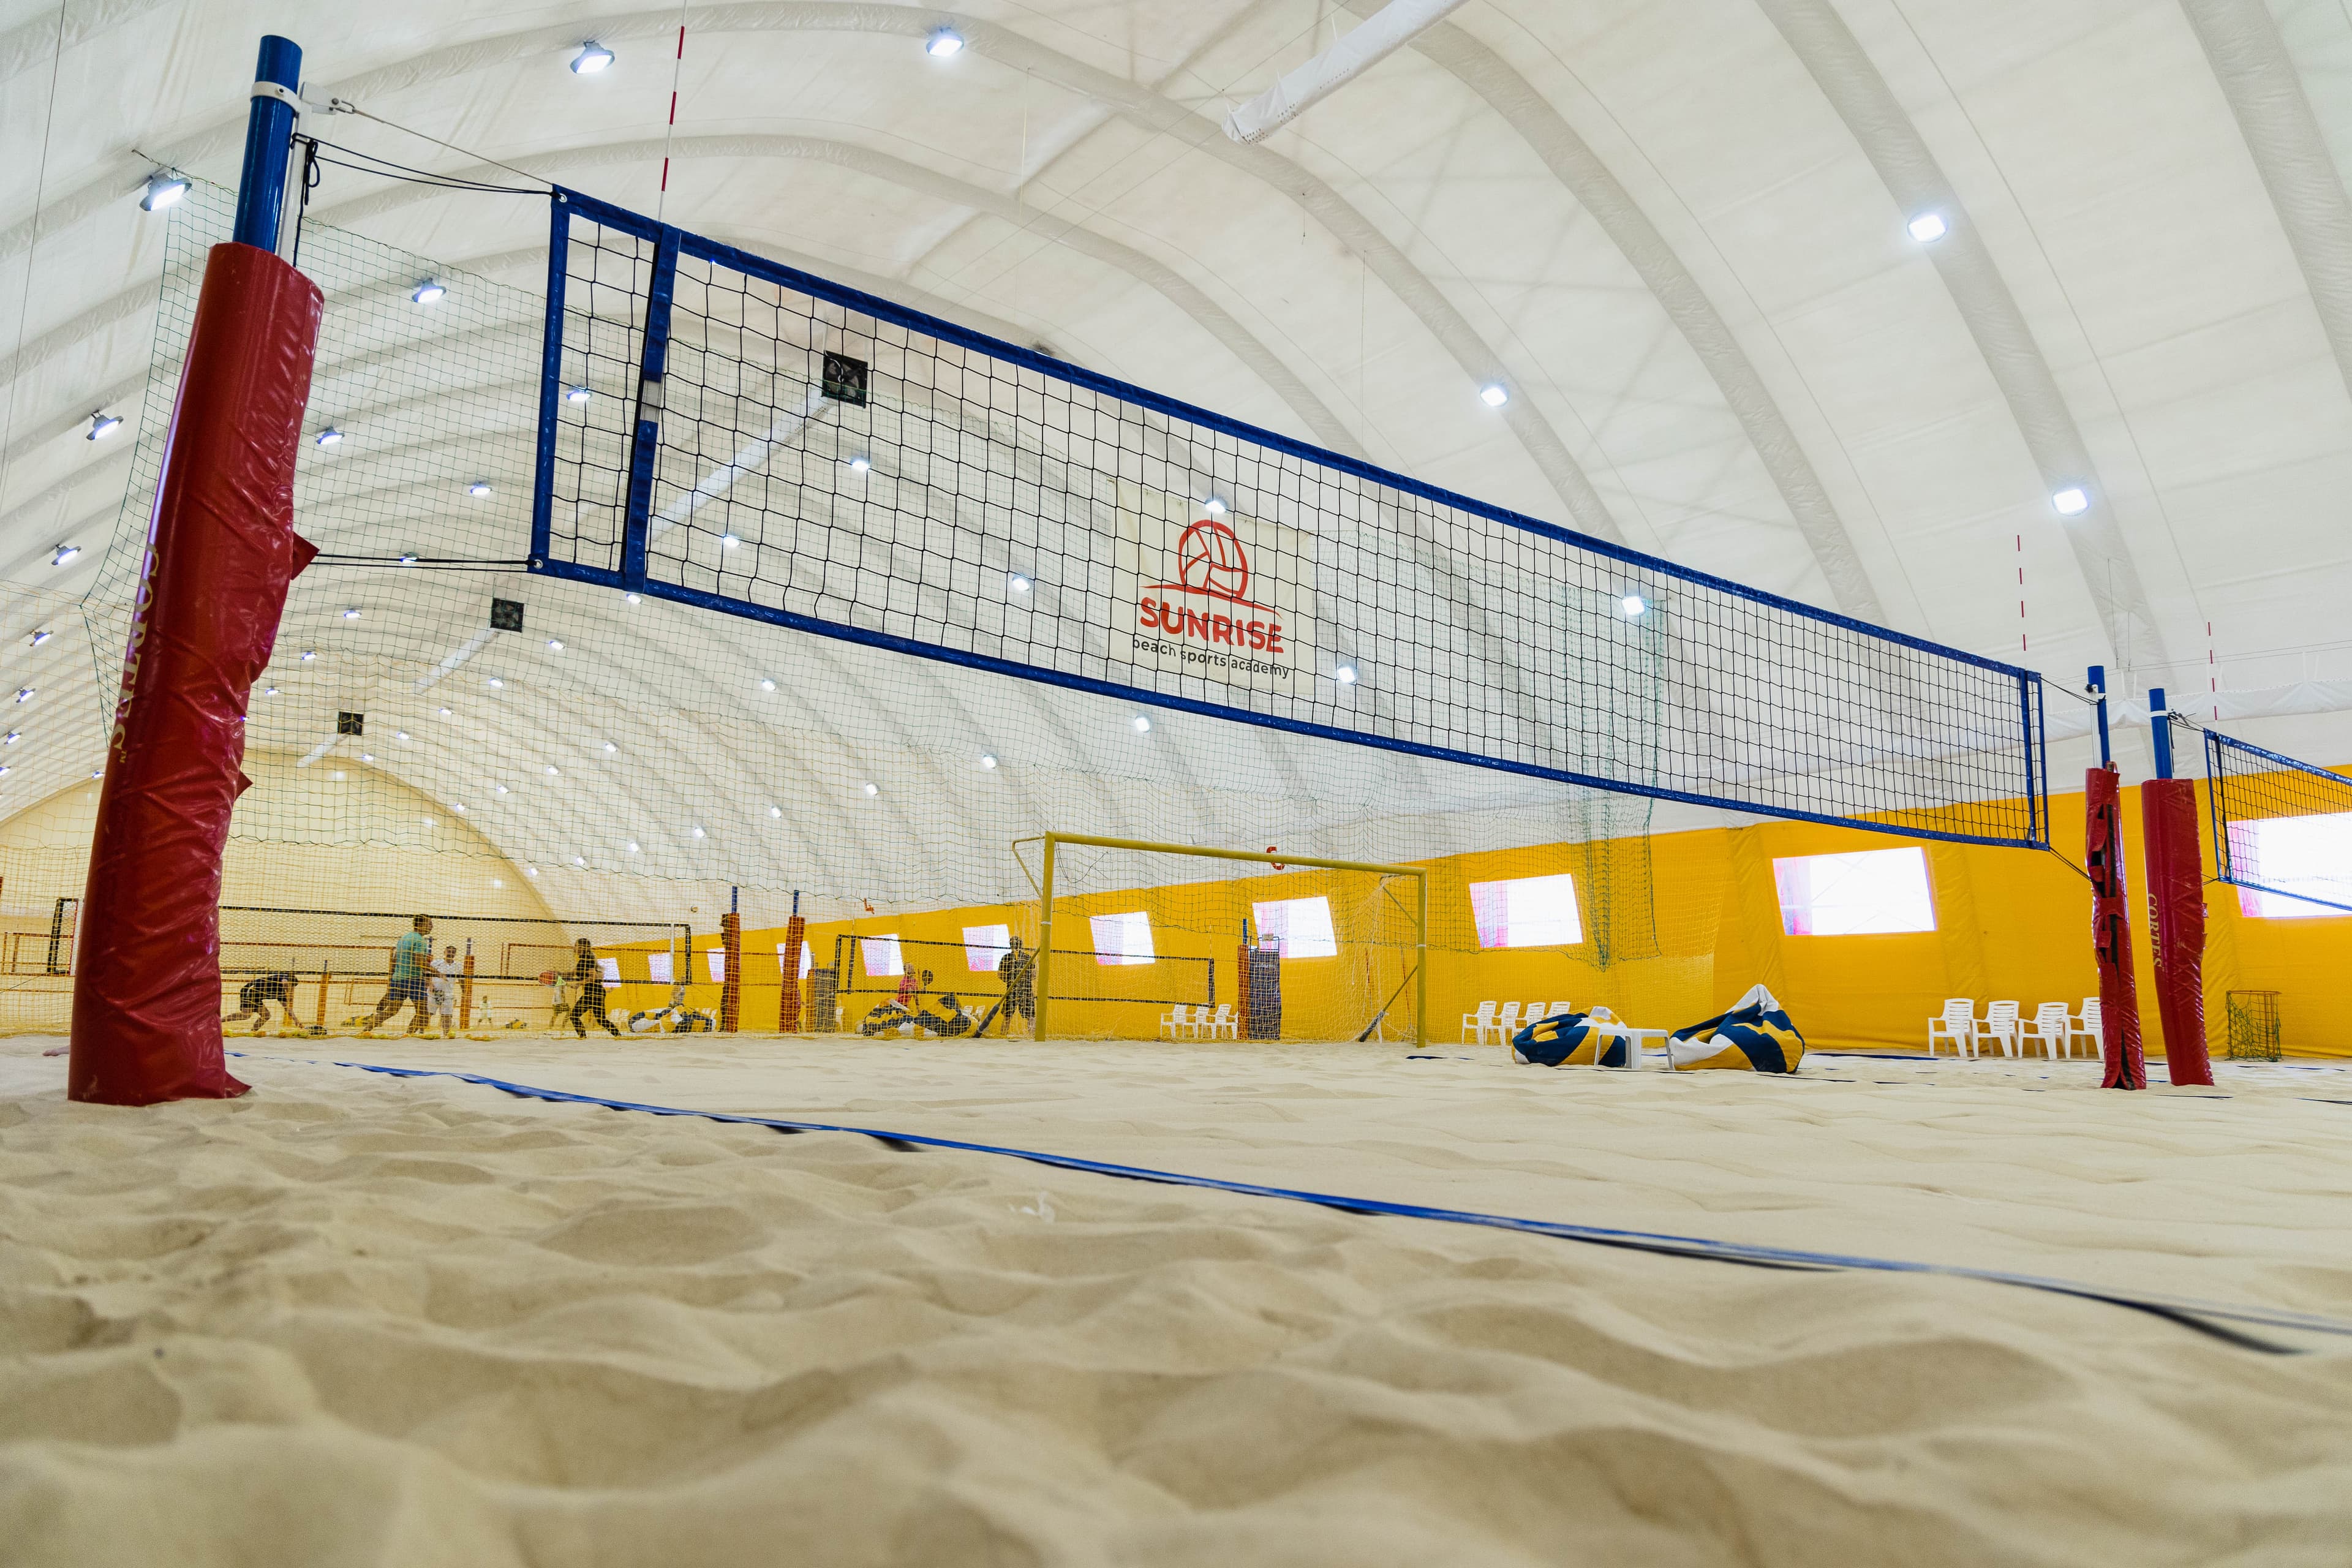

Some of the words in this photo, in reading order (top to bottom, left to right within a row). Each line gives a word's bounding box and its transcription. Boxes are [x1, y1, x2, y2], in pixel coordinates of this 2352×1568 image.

[1140, 597, 1284, 653] SUNRISE
[1133, 638, 1176, 657] beach
[1181, 649, 1226, 666] sports
[1231, 658, 1289, 679] academy
